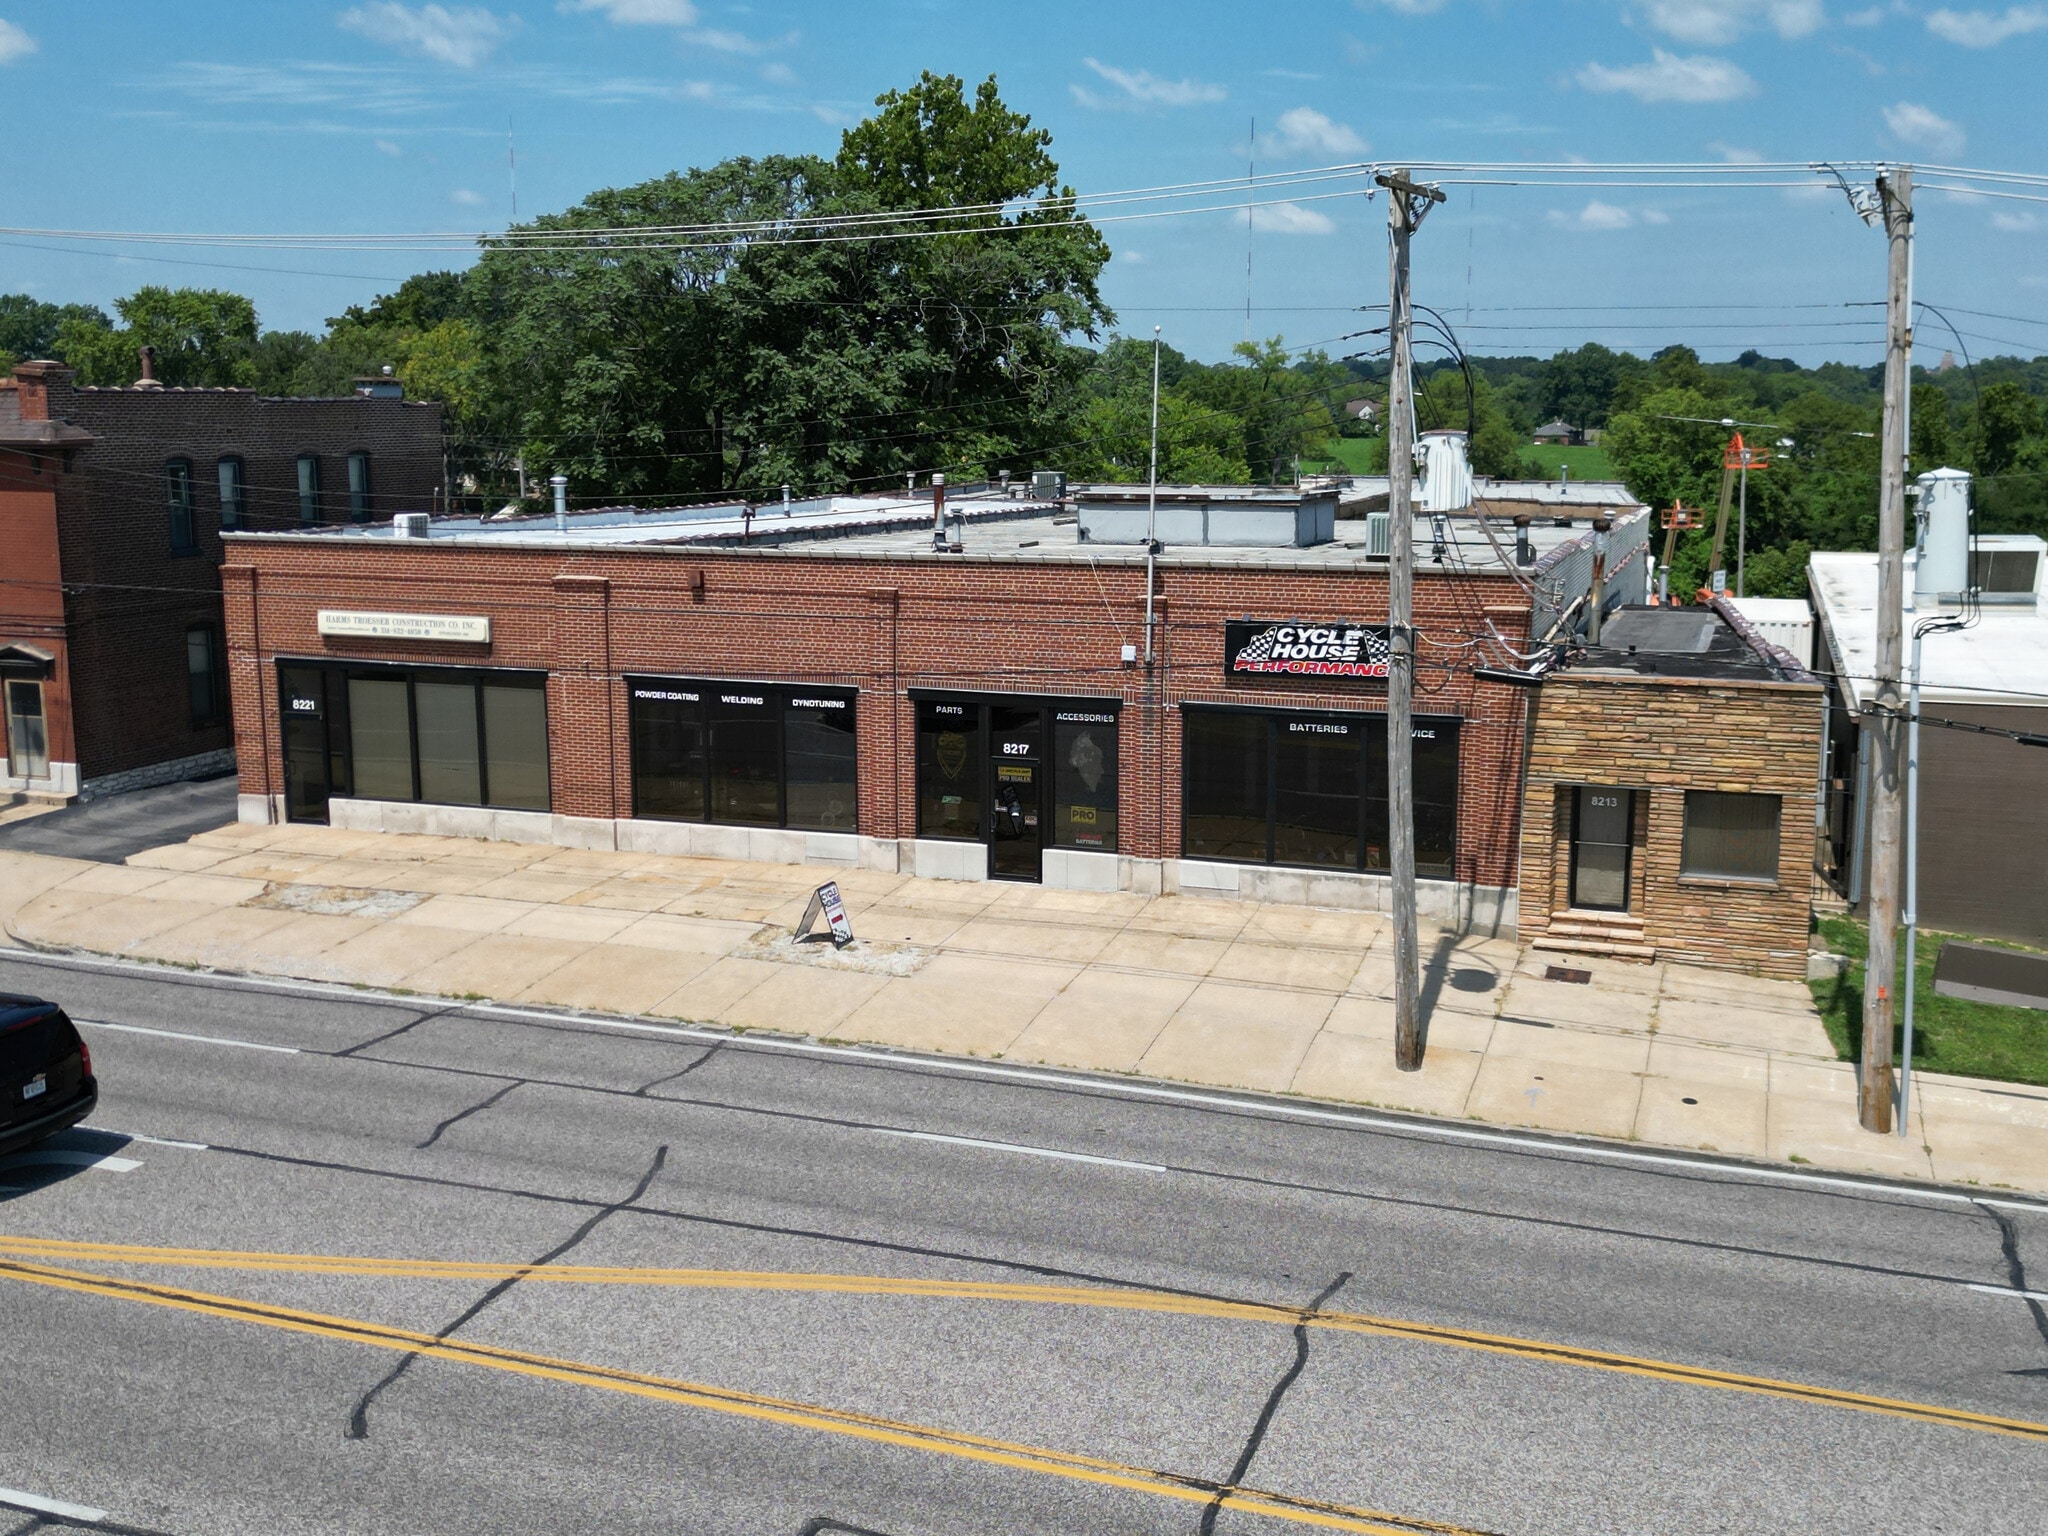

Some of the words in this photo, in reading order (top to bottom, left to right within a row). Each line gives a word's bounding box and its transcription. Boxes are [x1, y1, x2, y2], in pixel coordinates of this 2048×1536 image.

[326, 615, 351, 623] HARMS
[392, 618, 446, 628] CONSTRUCTION
[1277, 627, 1364, 645] CYCLE
[1271, 644, 1360, 661] HOUSE
[1234, 659, 1390, 677] PERFORMANC
[635, 690, 666, 700] POWDER
[667, 692, 699, 702] COATING
[721, 695, 763, 705] WELDING
[292, 699, 315, 710] 8221
[936, 706, 963, 715] PARTS
[1056, 713, 1115, 723] ACCESSORIES
[1289, 723, 1348, 734] BATTERIES
[1003, 743, 1029, 755] 8217
[1591, 796, 1618, 807] 8213
[1072, 809, 1095, 821] PRO
